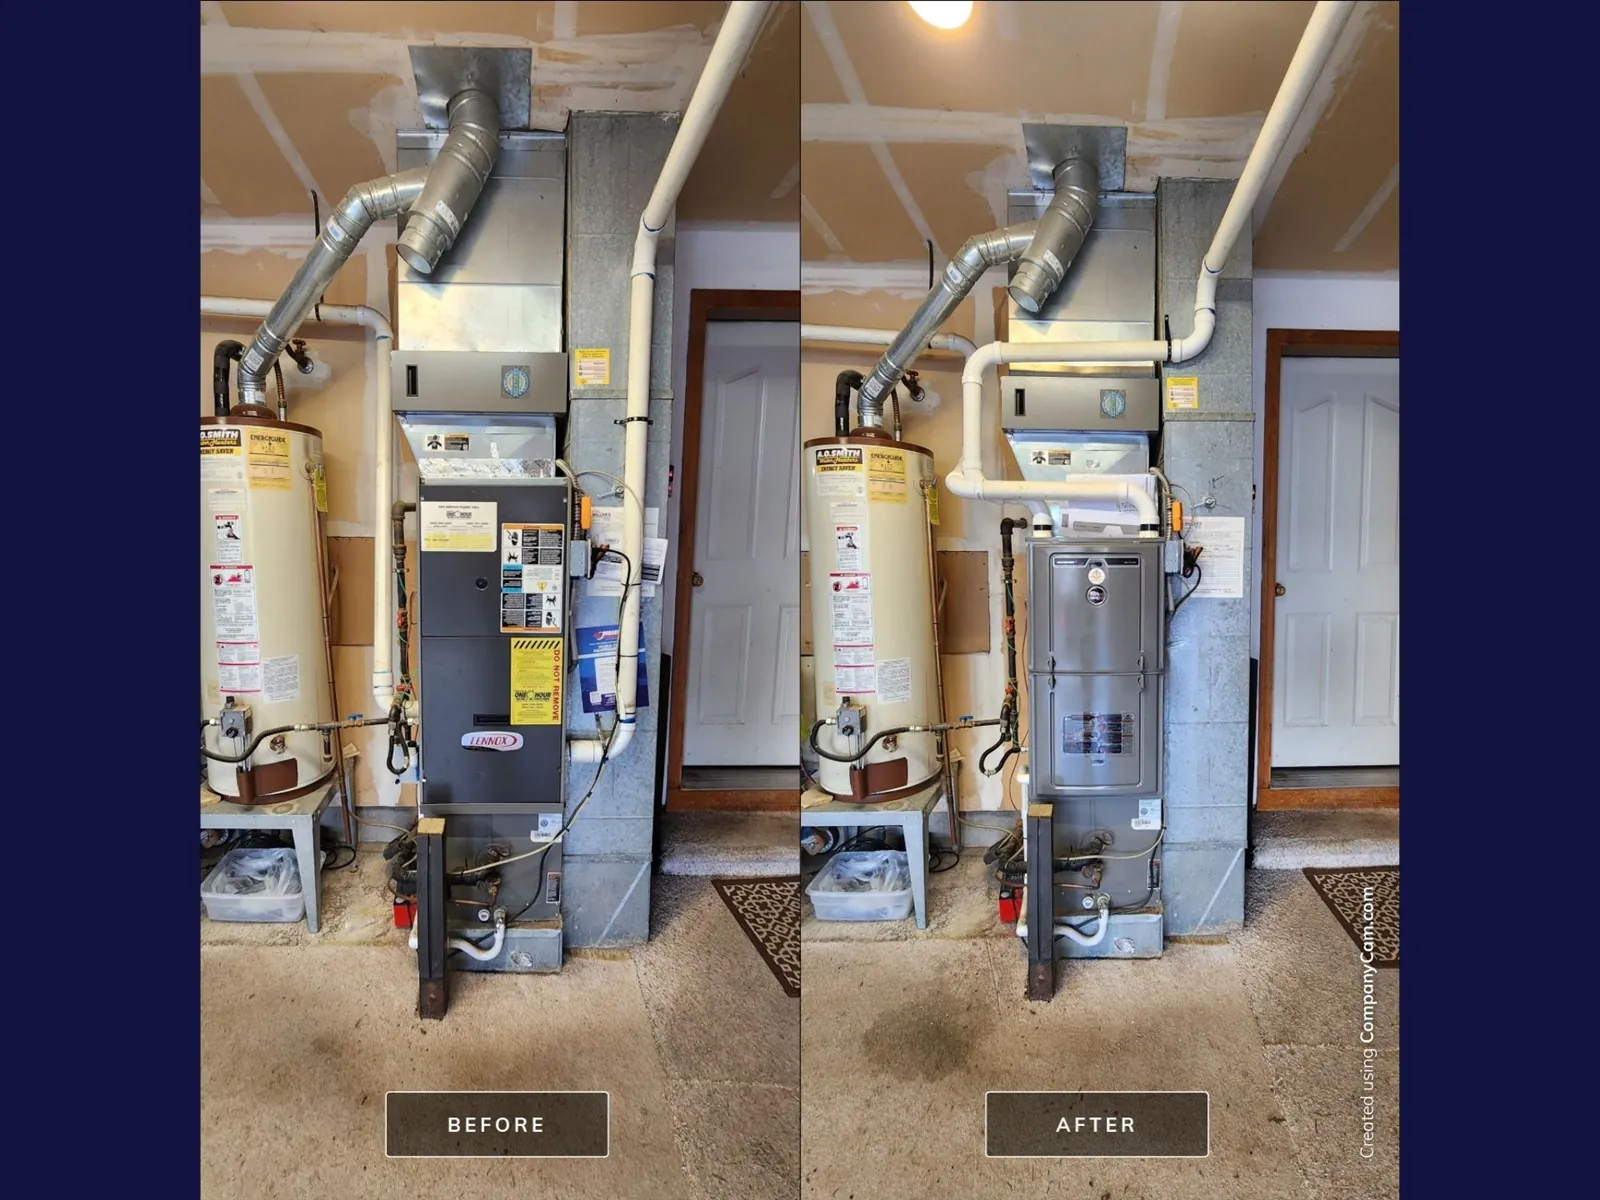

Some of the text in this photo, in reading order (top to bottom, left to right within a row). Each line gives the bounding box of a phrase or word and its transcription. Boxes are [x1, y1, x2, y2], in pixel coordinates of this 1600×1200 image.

[553, 650, 561, 662] DO
[552, 686, 560, 721] REMOVE
[470, 736, 508, 746] LENNOX
